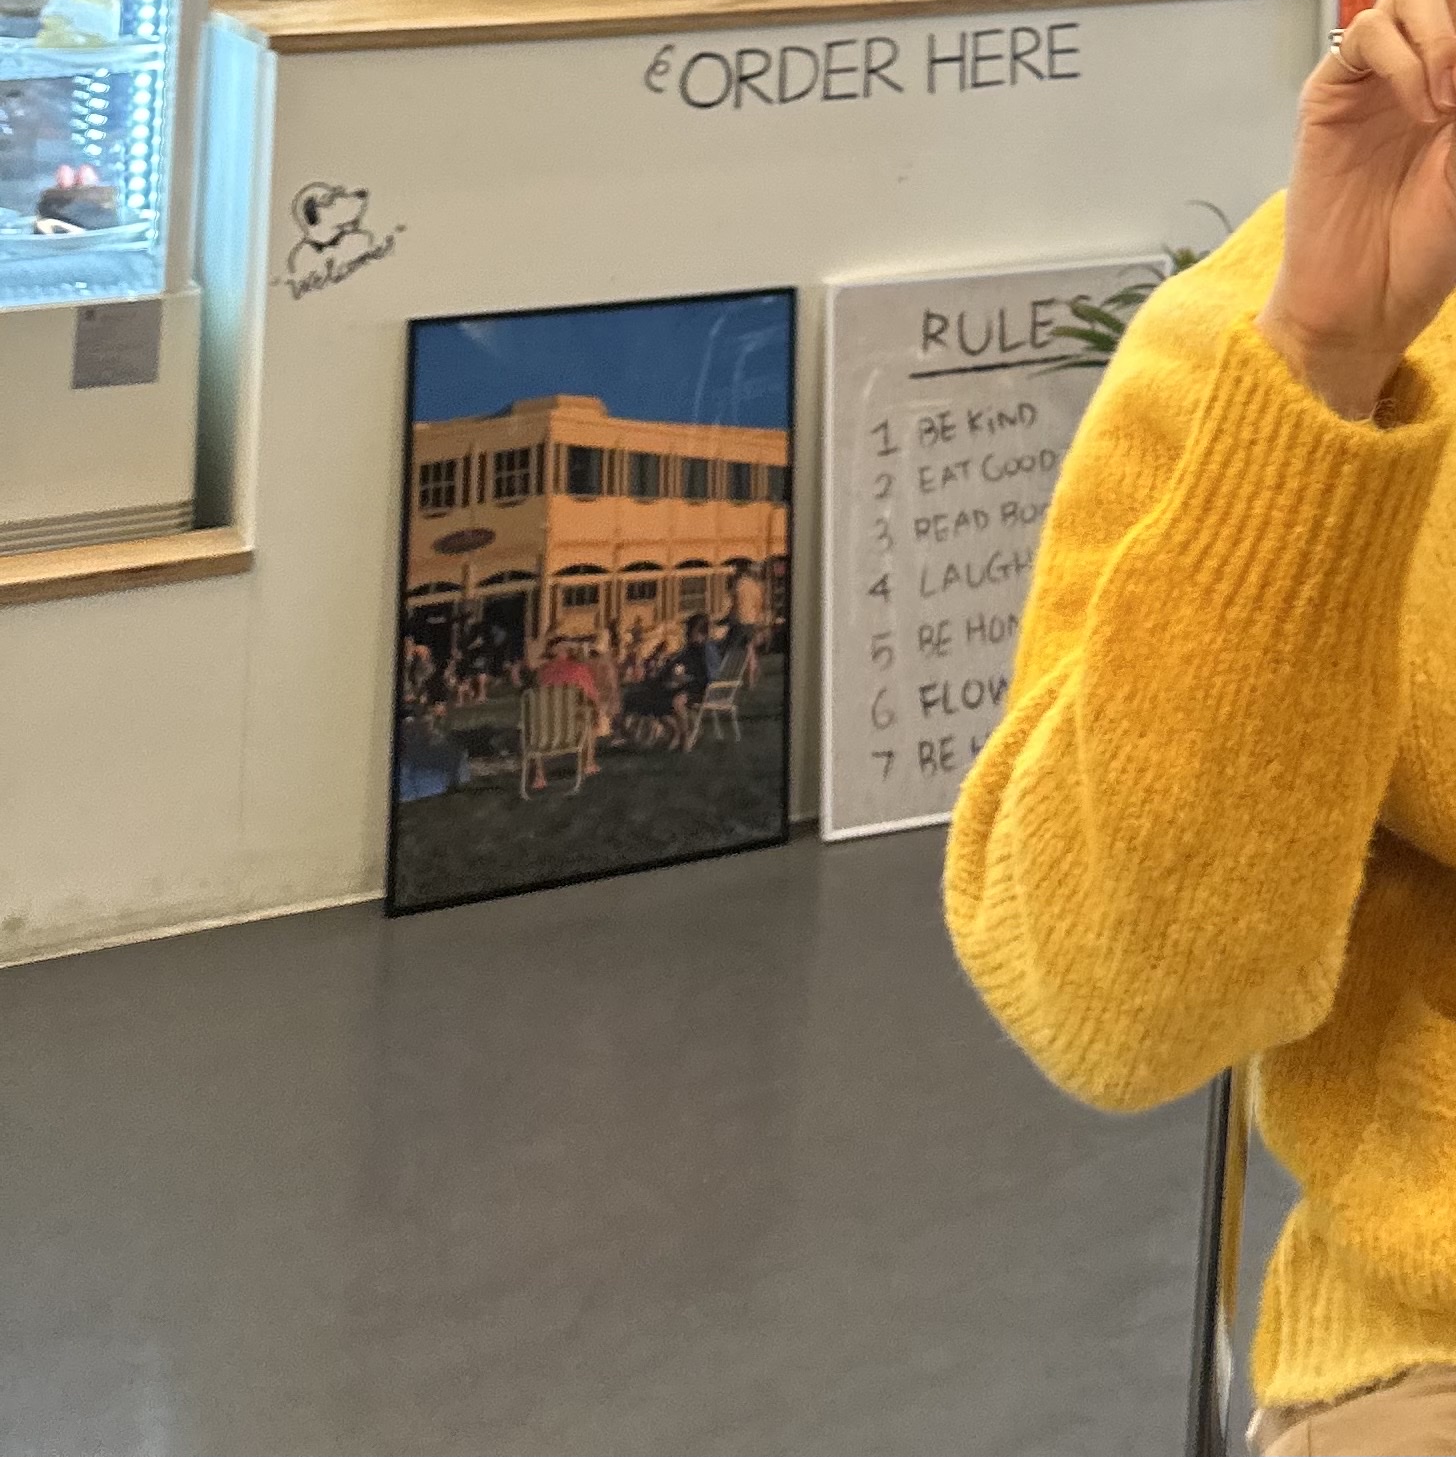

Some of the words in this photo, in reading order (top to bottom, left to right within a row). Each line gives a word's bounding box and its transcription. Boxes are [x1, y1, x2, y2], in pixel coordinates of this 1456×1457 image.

[679, 36, 904, 110] ORDER
[927, 22, 1082, 95] HERE
[870, 418, 899, 457] 1
[918, 410, 957, 450] BE
[873, 472, 895, 500] 2
[918, 458, 973, 495] EAT
[981, 448, 1059, 483] GOOD
[868, 572, 892, 603] 4
[871, 629, 895, 673] 5
[871, 686, 896, 731] 6
[871, 747, 895, 780] 7
[916, 734, 957, 777] BE
